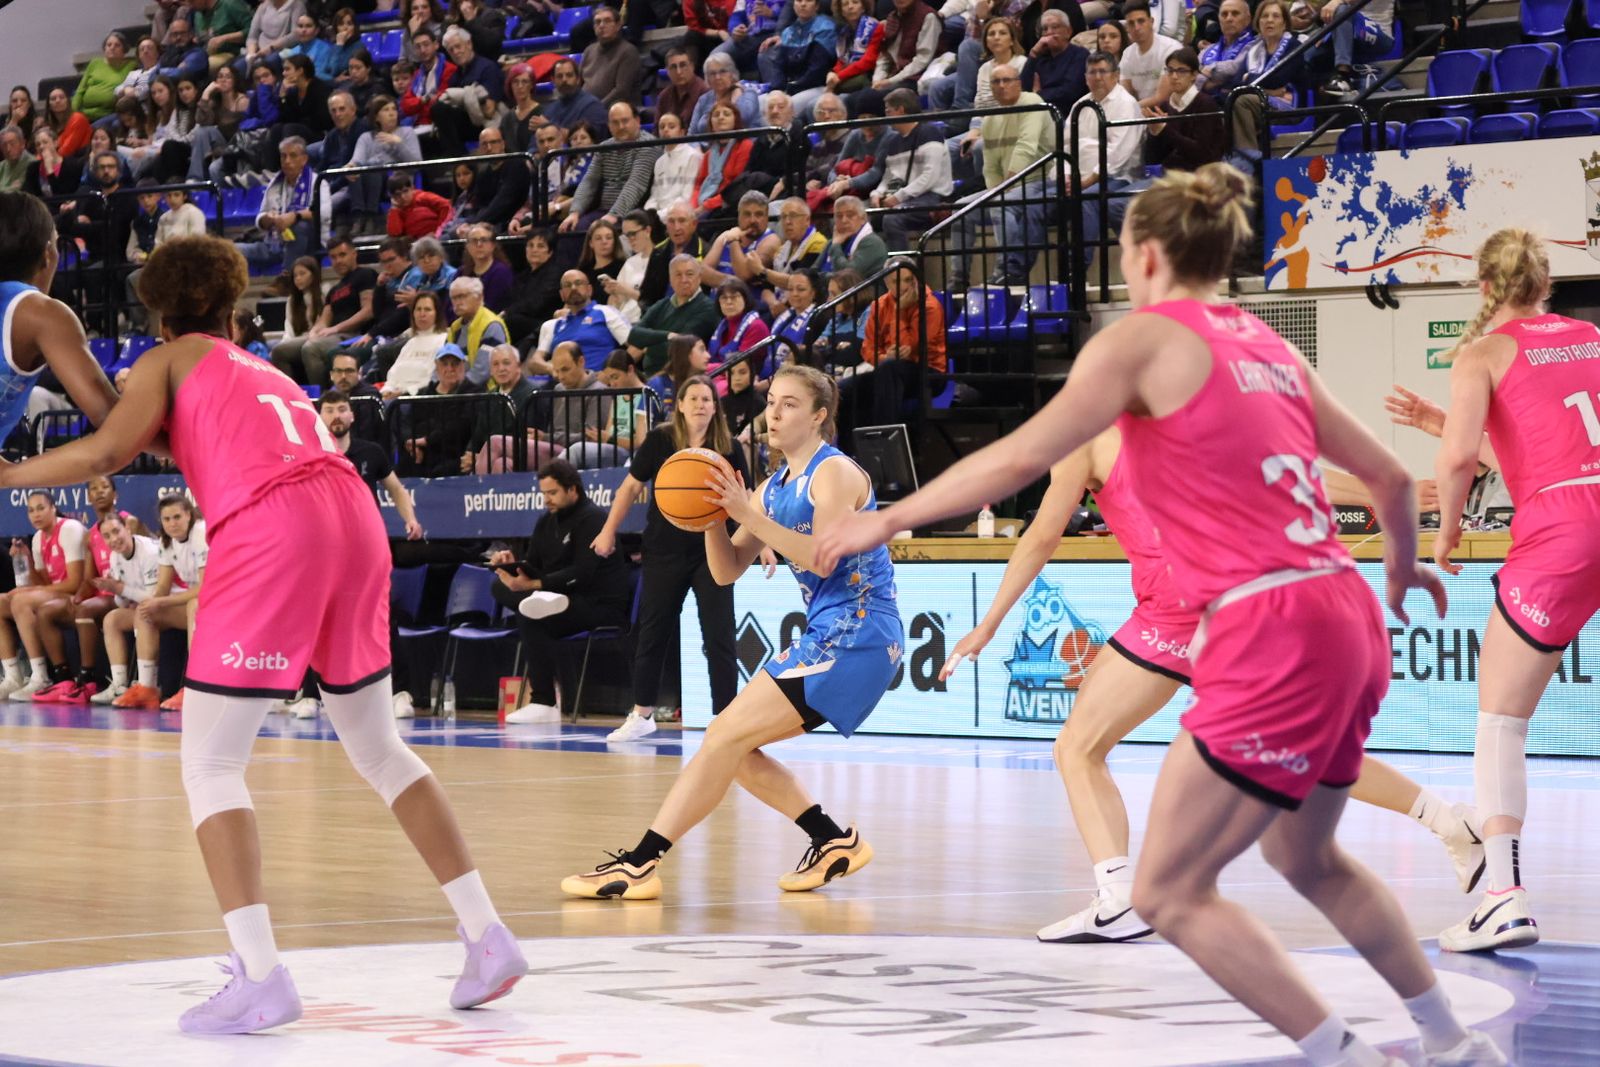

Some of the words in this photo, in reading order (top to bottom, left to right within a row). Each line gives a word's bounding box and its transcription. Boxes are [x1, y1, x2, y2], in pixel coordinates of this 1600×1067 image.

[1432, 323, 1463, 336] SALIDA
[1521, 603, 1551, 628] eitb
[245, 651, 289, 670] eitb
